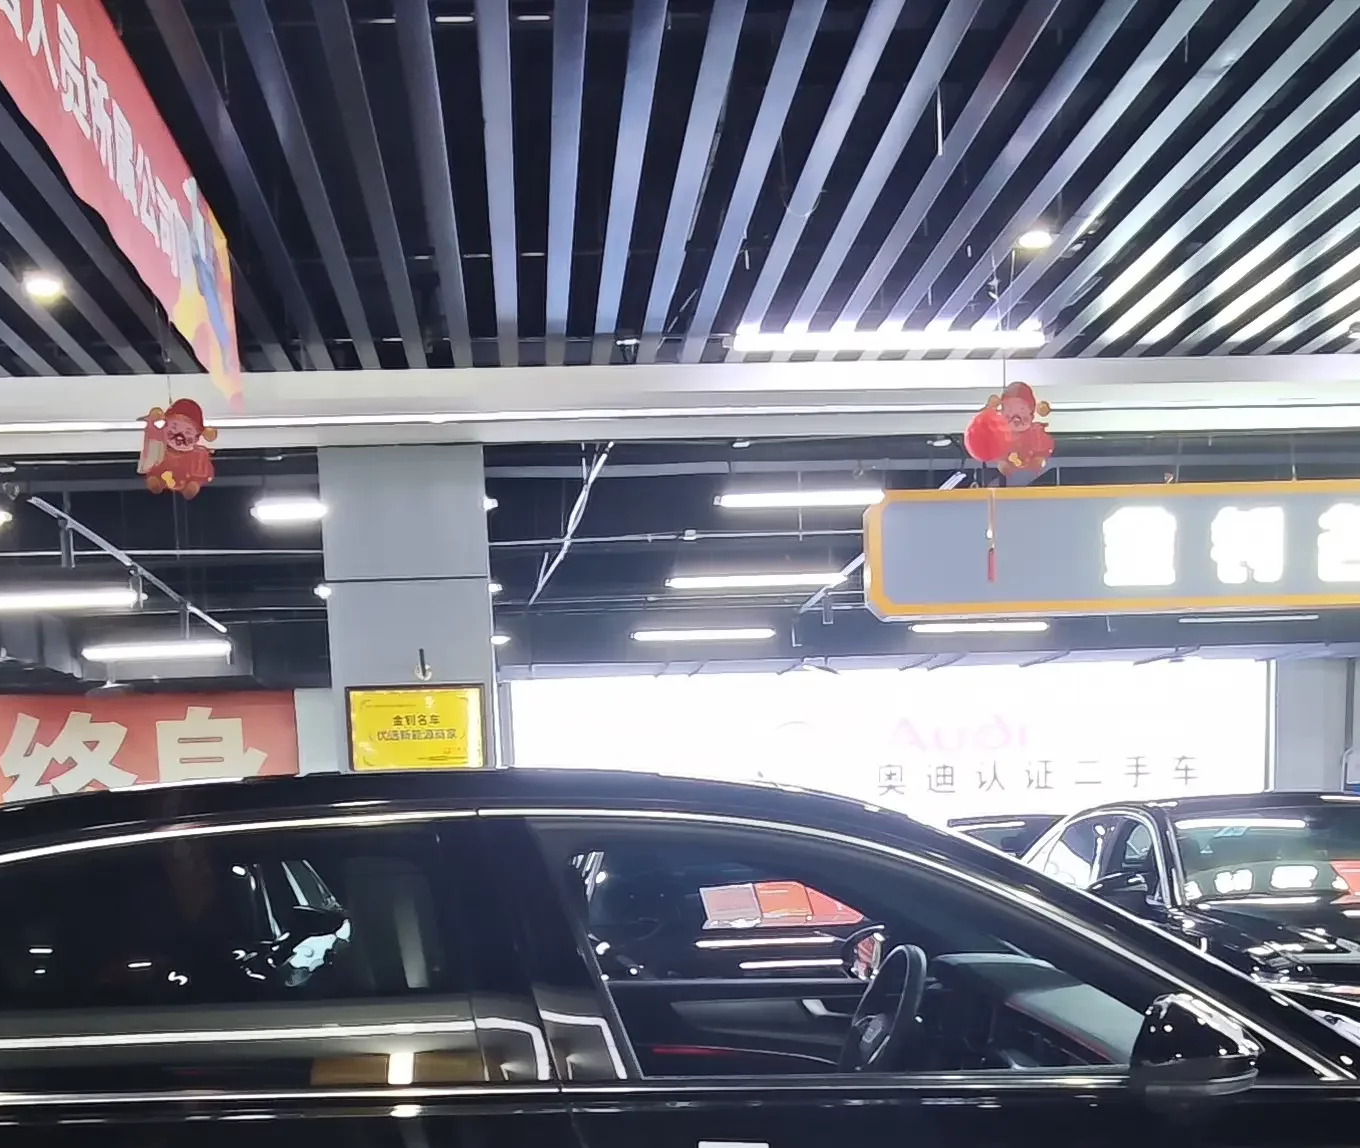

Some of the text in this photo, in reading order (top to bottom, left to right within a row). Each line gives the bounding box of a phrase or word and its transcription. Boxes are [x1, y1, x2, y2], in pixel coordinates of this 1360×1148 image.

[877, 754, 1199, 796] 奥迪认证二手车
